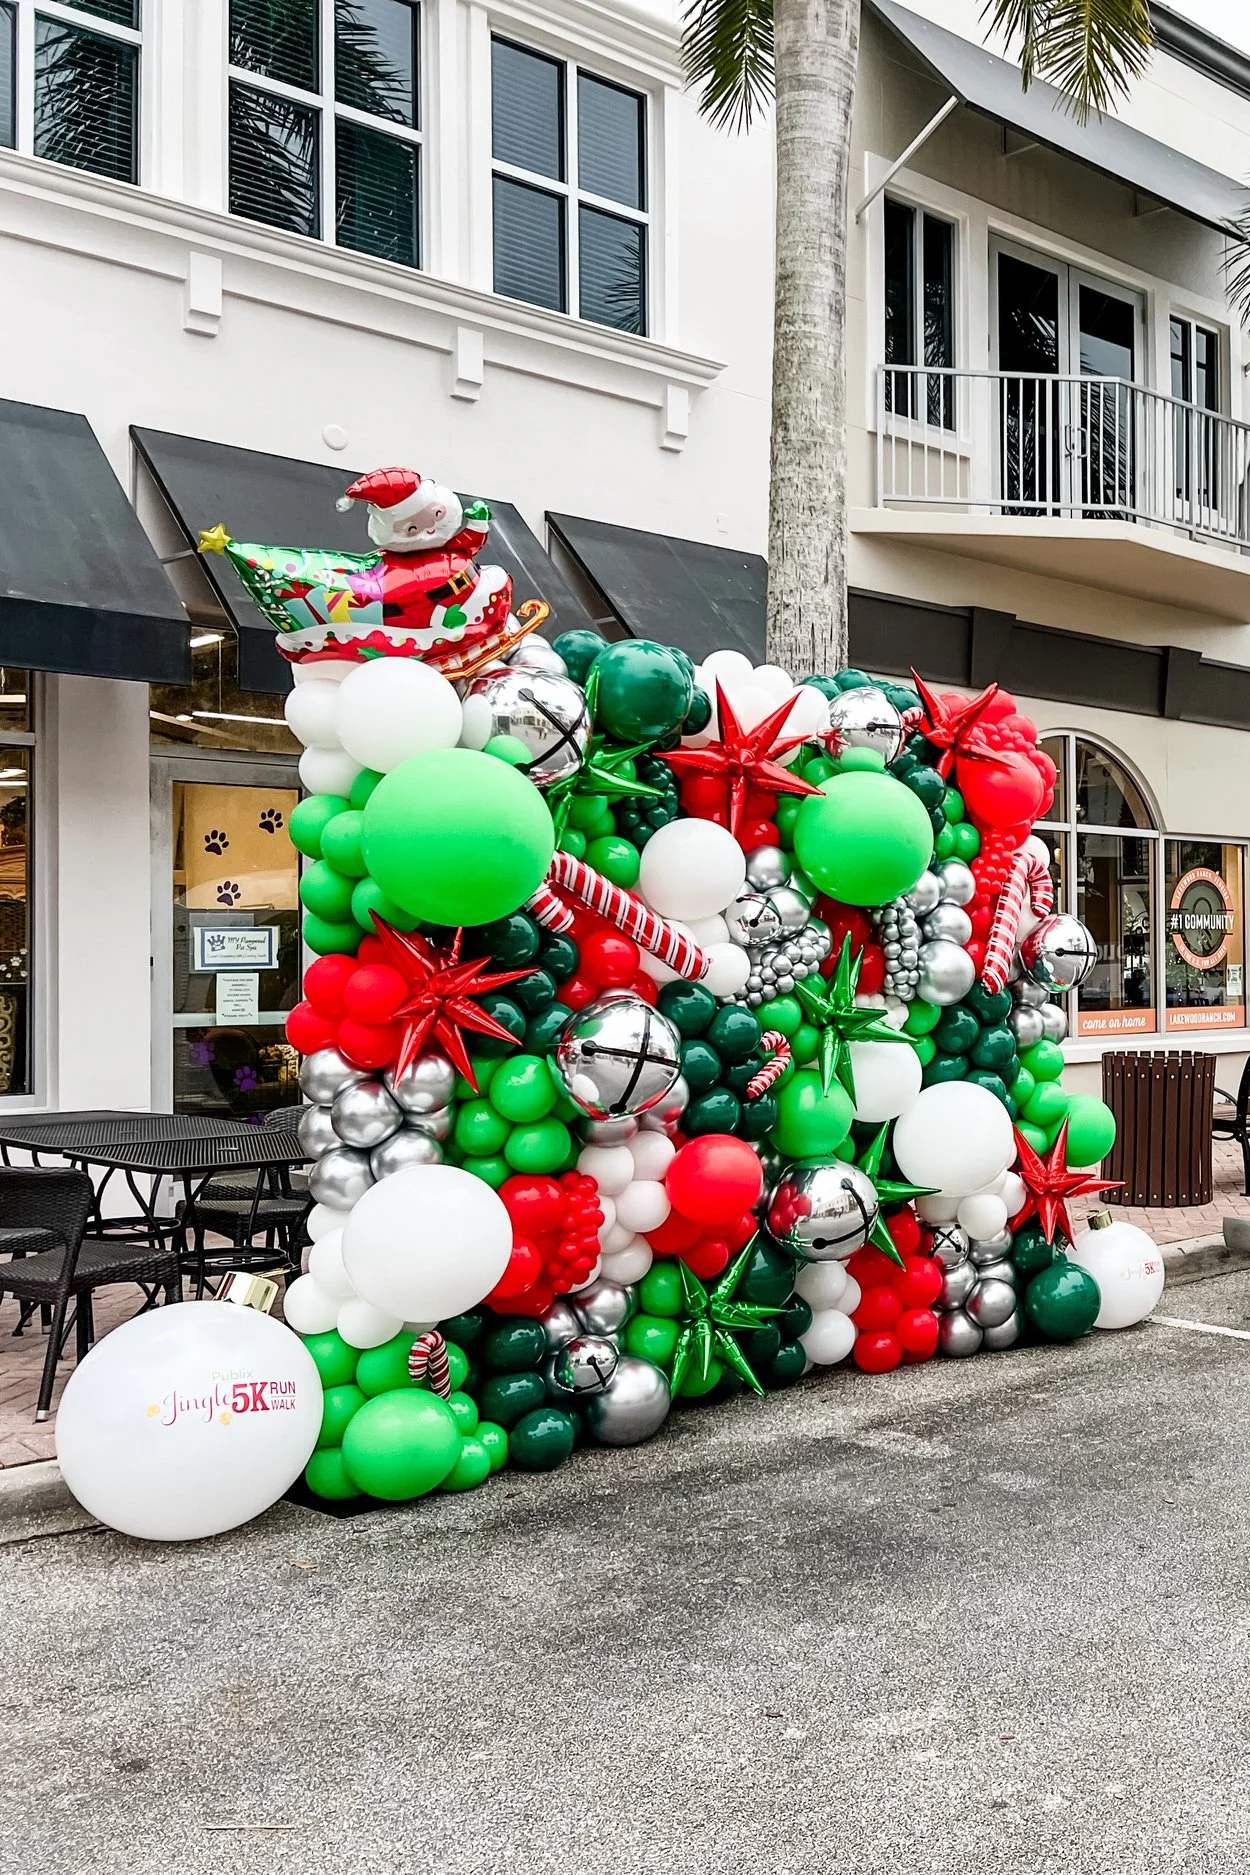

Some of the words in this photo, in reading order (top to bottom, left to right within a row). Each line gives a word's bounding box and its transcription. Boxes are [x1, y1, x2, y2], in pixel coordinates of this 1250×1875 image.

[1171, 913, 1183, 930] #1
[1184, 913, 1234, 930] COMMUNITY
[246, 944, 256, 952] Spa
[1082, 1018, 1106, 1030] come
[1109, 1018, 1121, 1029] on
[1122, 1014, 1146, 1028] home
[1169, 1012, 1236, 1026] LAKEWOODRANCH.COM
[211, 1368, 254, 1381] Publix
[270, 1381, 296, 1394] RUN
[161, 1383, 232, 1426] Jingle
[232, 1382, 270, 1414] 5K
[271, 1399, 296, 1410] WALK
